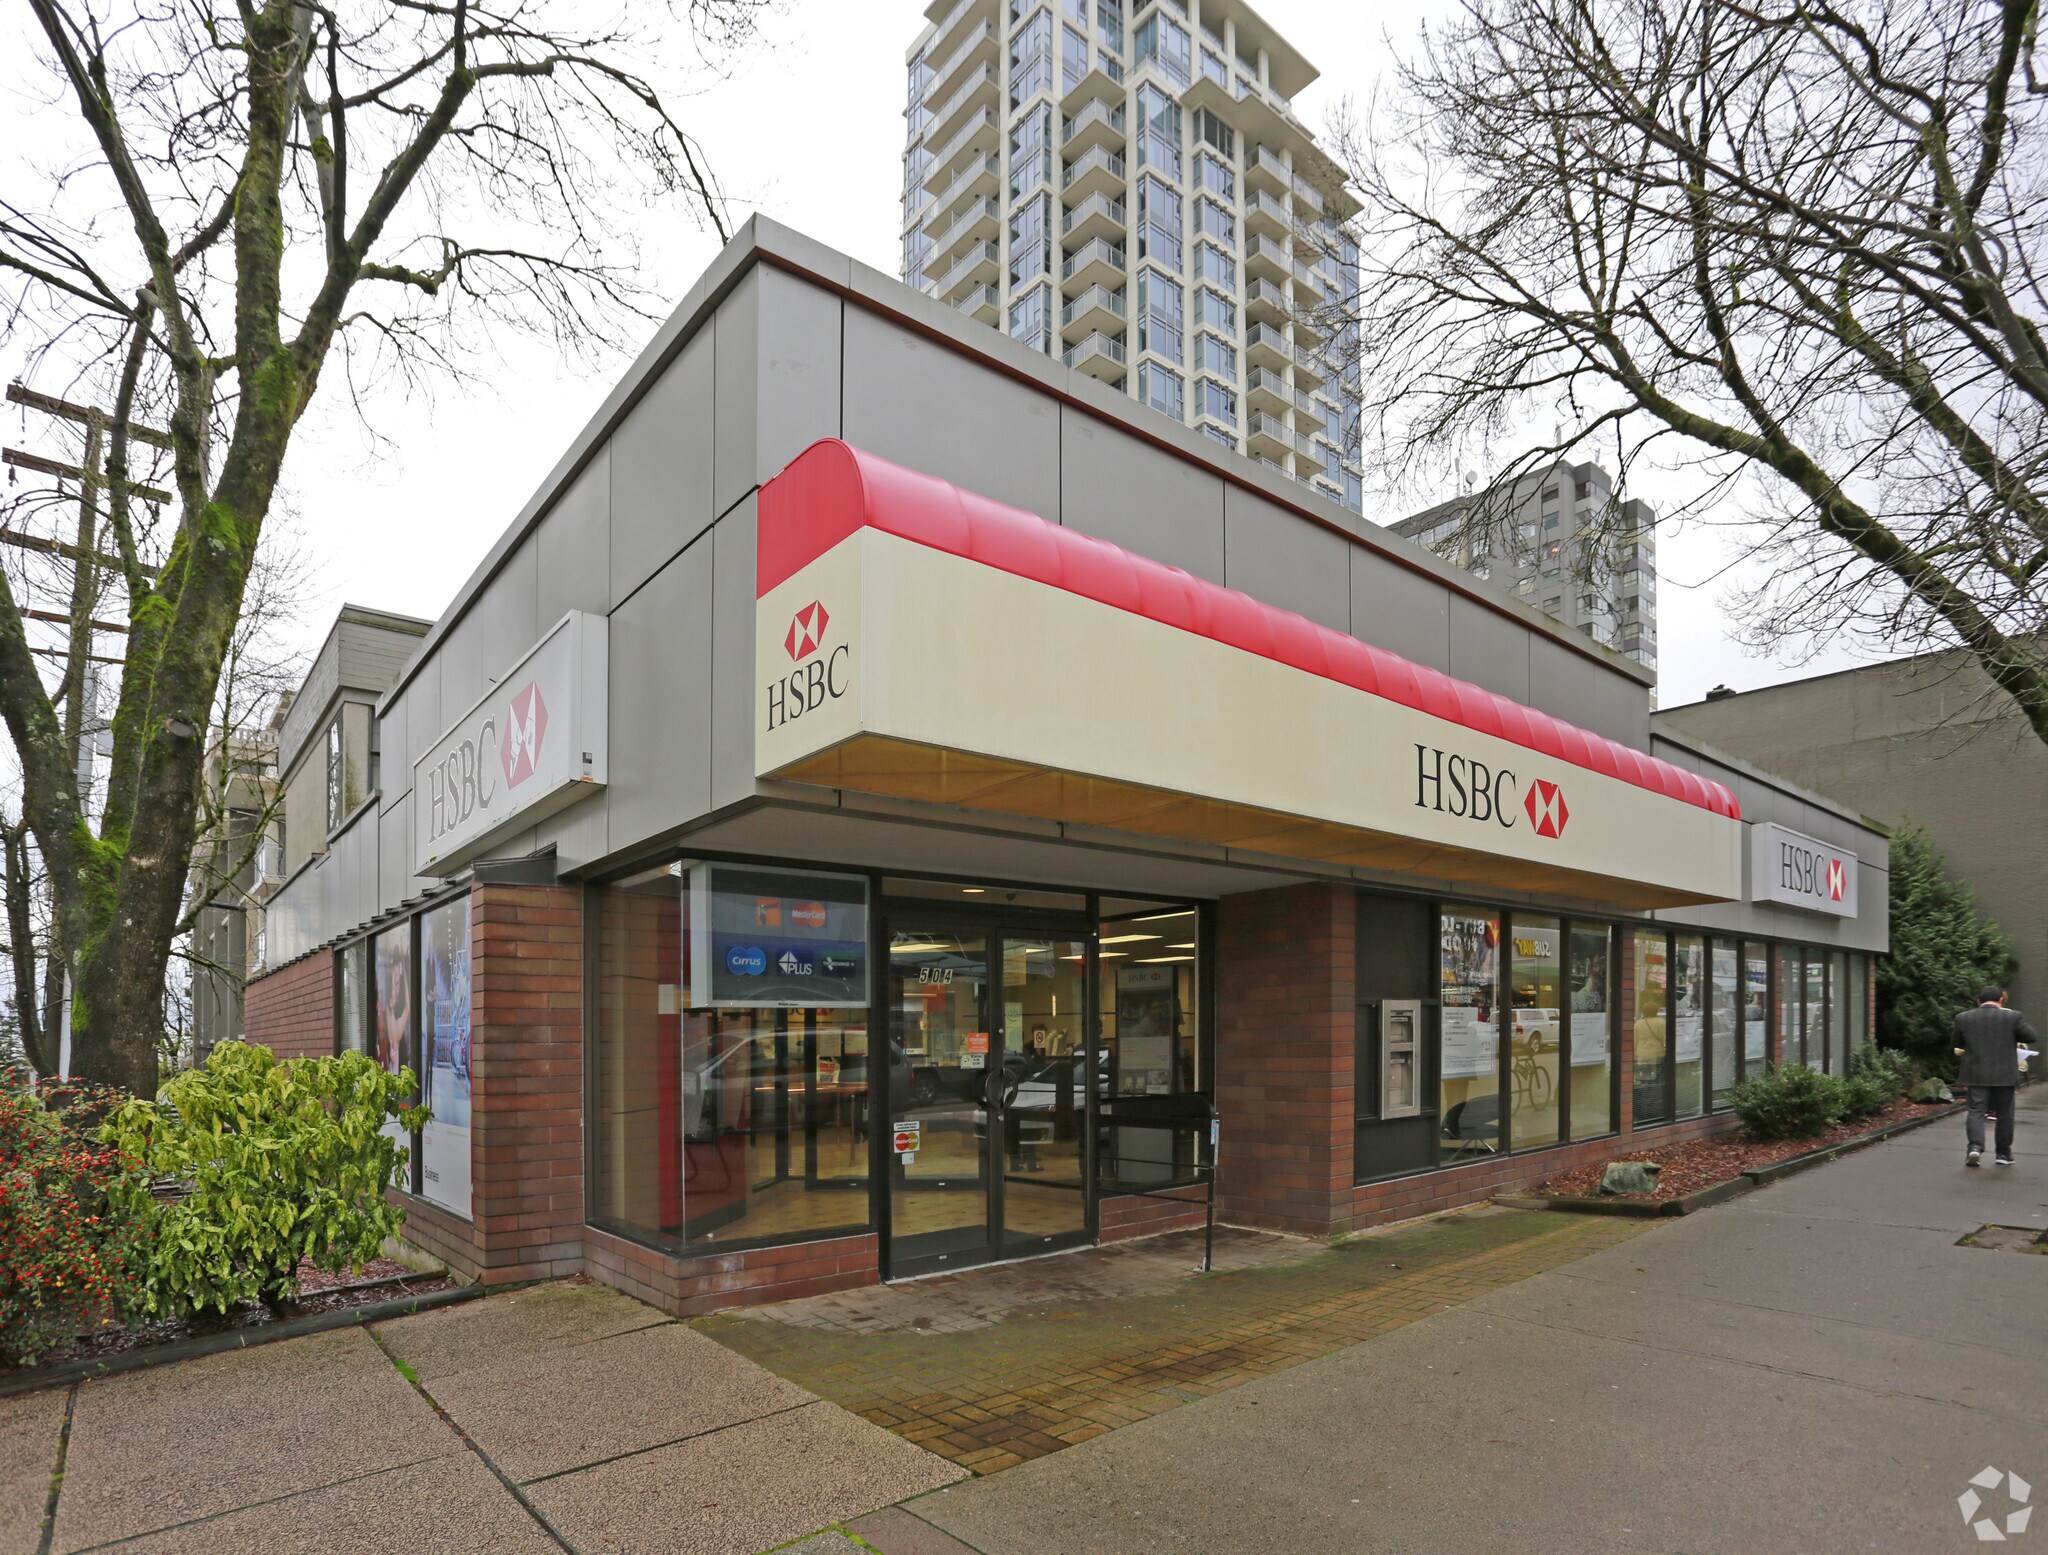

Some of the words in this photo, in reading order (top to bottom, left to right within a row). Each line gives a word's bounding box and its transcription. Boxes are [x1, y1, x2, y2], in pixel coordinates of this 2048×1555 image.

[767, 642, 849, 732] HSBC
[427, 713, 497, 846] HSBC
[1414, 743, 1517, 828] HSBC
[1780, 842, 1824, 897] HSBC
[791, 909, 826, 920] MasterCard
[732, 956, 761, 966] Cirrus
[787, 962, 813, 975] PLUS
[919, 967, 953, 984] 504
